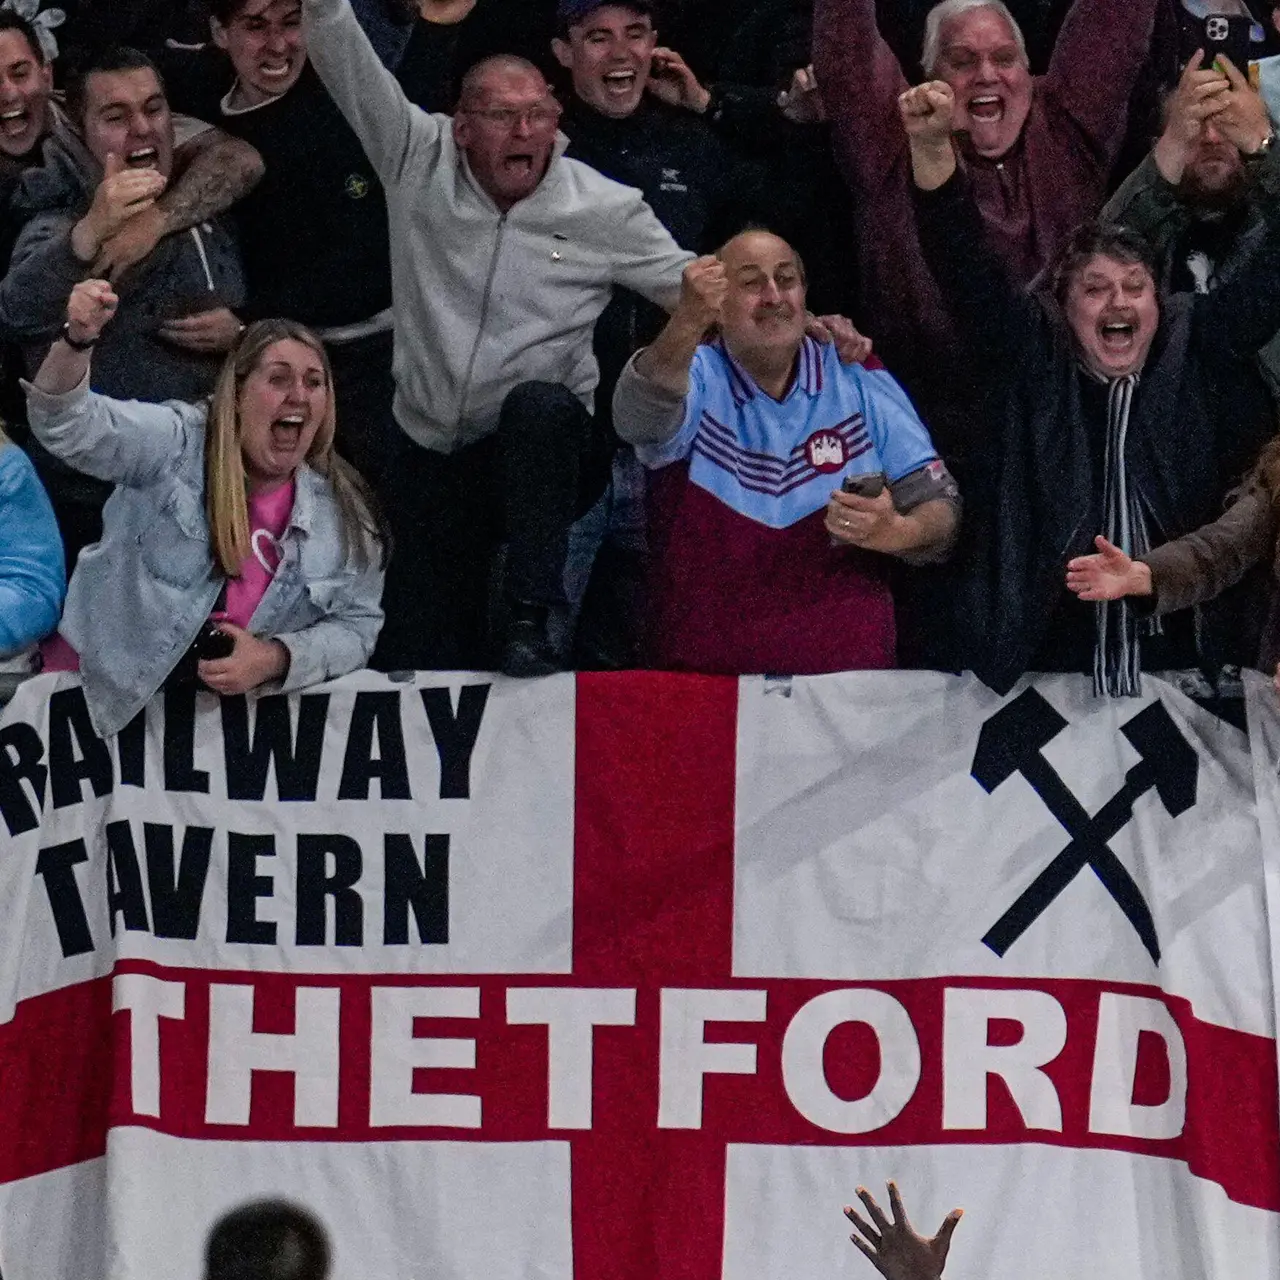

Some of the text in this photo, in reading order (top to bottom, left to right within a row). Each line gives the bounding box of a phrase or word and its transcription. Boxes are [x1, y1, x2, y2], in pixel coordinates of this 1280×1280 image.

[0, 684, 492, 837] RAILWAY
[35, 820, 450, 959] TAVERN
[111, 972, 1189, 1141] THETFORD
